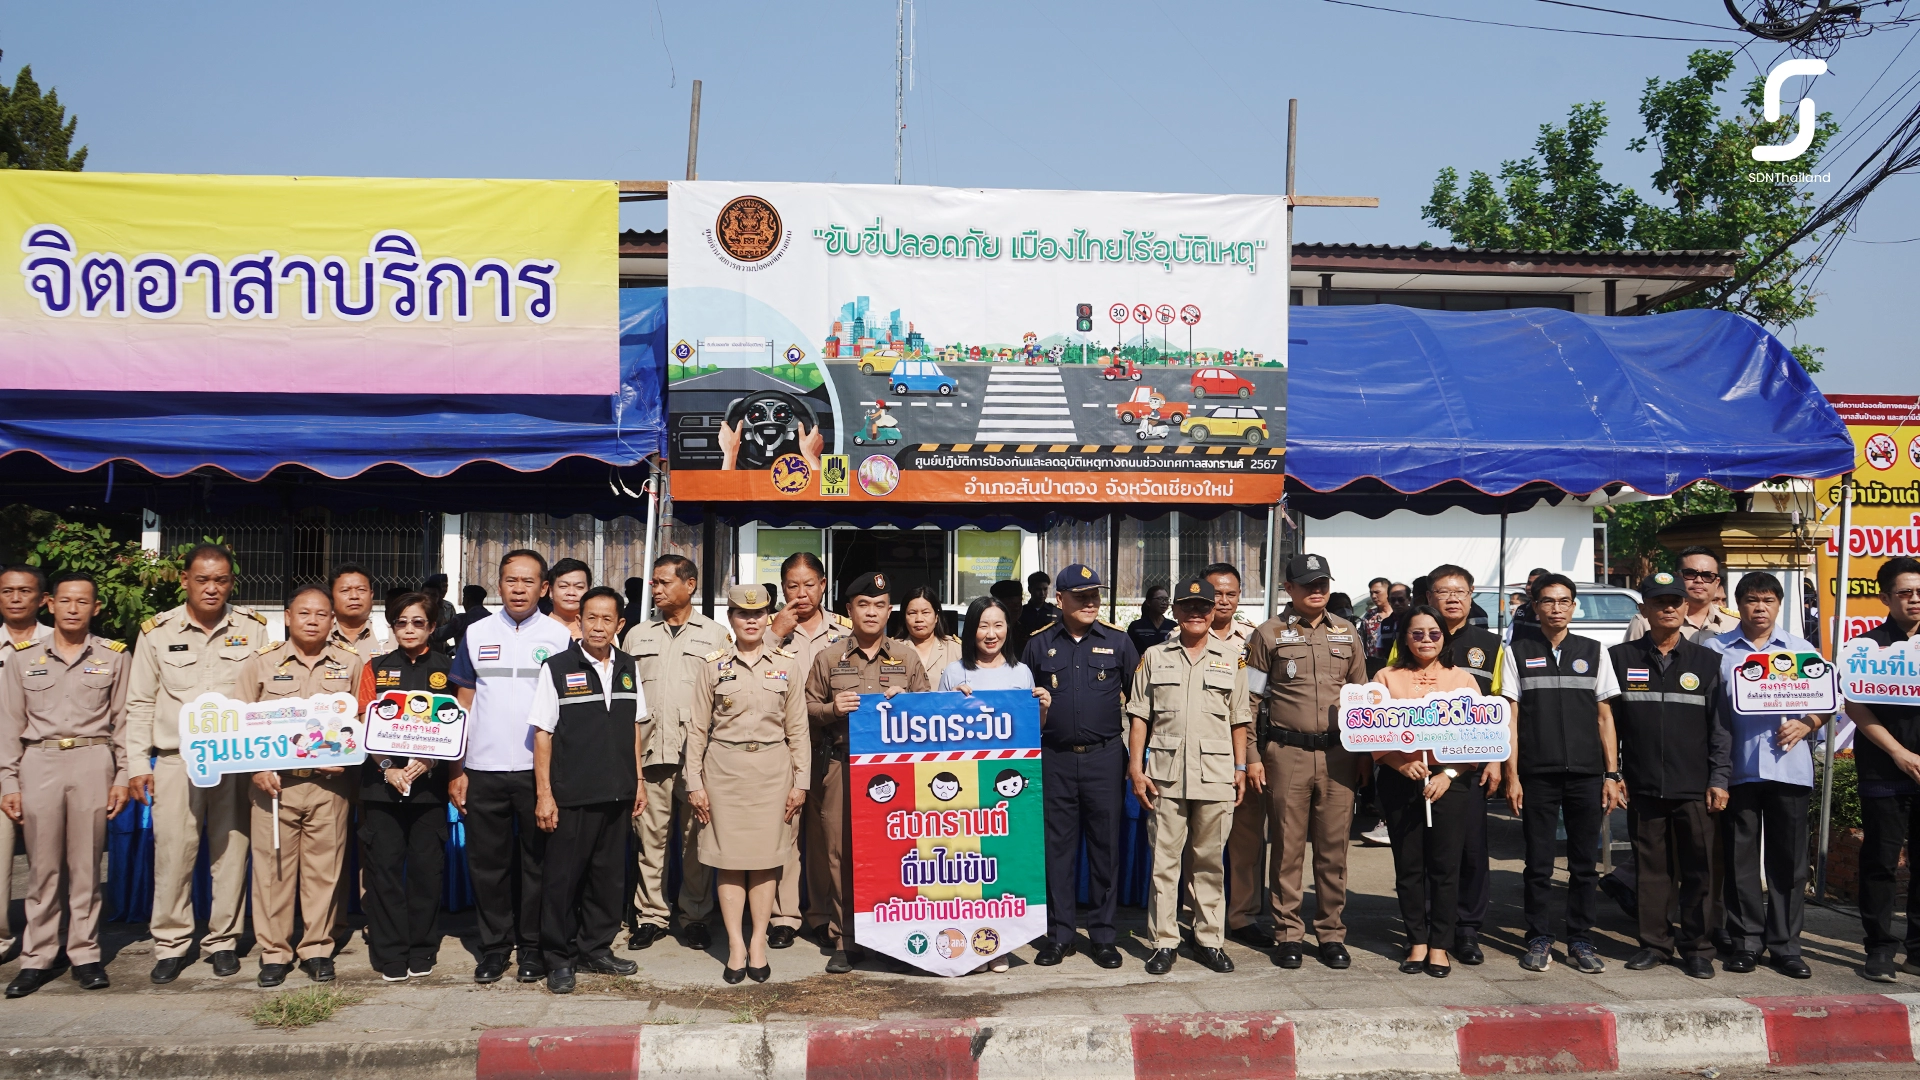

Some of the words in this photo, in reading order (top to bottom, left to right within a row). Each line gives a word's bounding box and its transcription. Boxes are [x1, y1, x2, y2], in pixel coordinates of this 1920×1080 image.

[813, 216, 1001, 258] "ขับขี่ปลอดภัย
[1011, 227, 1267, 275] เมืองไทยไร้อุบัติเหตุ"
[26, 228, 557, 320] จิตอาสาบริการ
[1113, 308, 1125, 317] 30
[1250, 459, 1277, 469] 2567
[964, 476, 1098, 497] อำเภอสันป่าตอง
[1105, 479, 1234, 498] จังหวัดเชียงใหม่
[1846, 646, 1920, 677] พื้นที่เ
[1759, 680, 1809, 691] สงกรานต์
[188, 702, 238, 734] เลิก
[876, 701, 1012, 744] โปรดระวัง
[1347, 696, 1503, 728] สงกรานต์วิถีไทย
[392, 724, 440, 735] สงกรานต์
[1348, 730, 1399, 744] ปลอดเหล้า
[1416, 730, 1457, 742] ปลอดภัย
[190, 734, 288, 776] รุนแรง
[1441, 744, 1503, 756] #safezone
[887, 801, 1010, 840] สงกรานต์
[901, 848, 997, 886] ดื่มไม่ขับ
[874, 894, 1027, 923] กลับบ้านปลอดภัย
